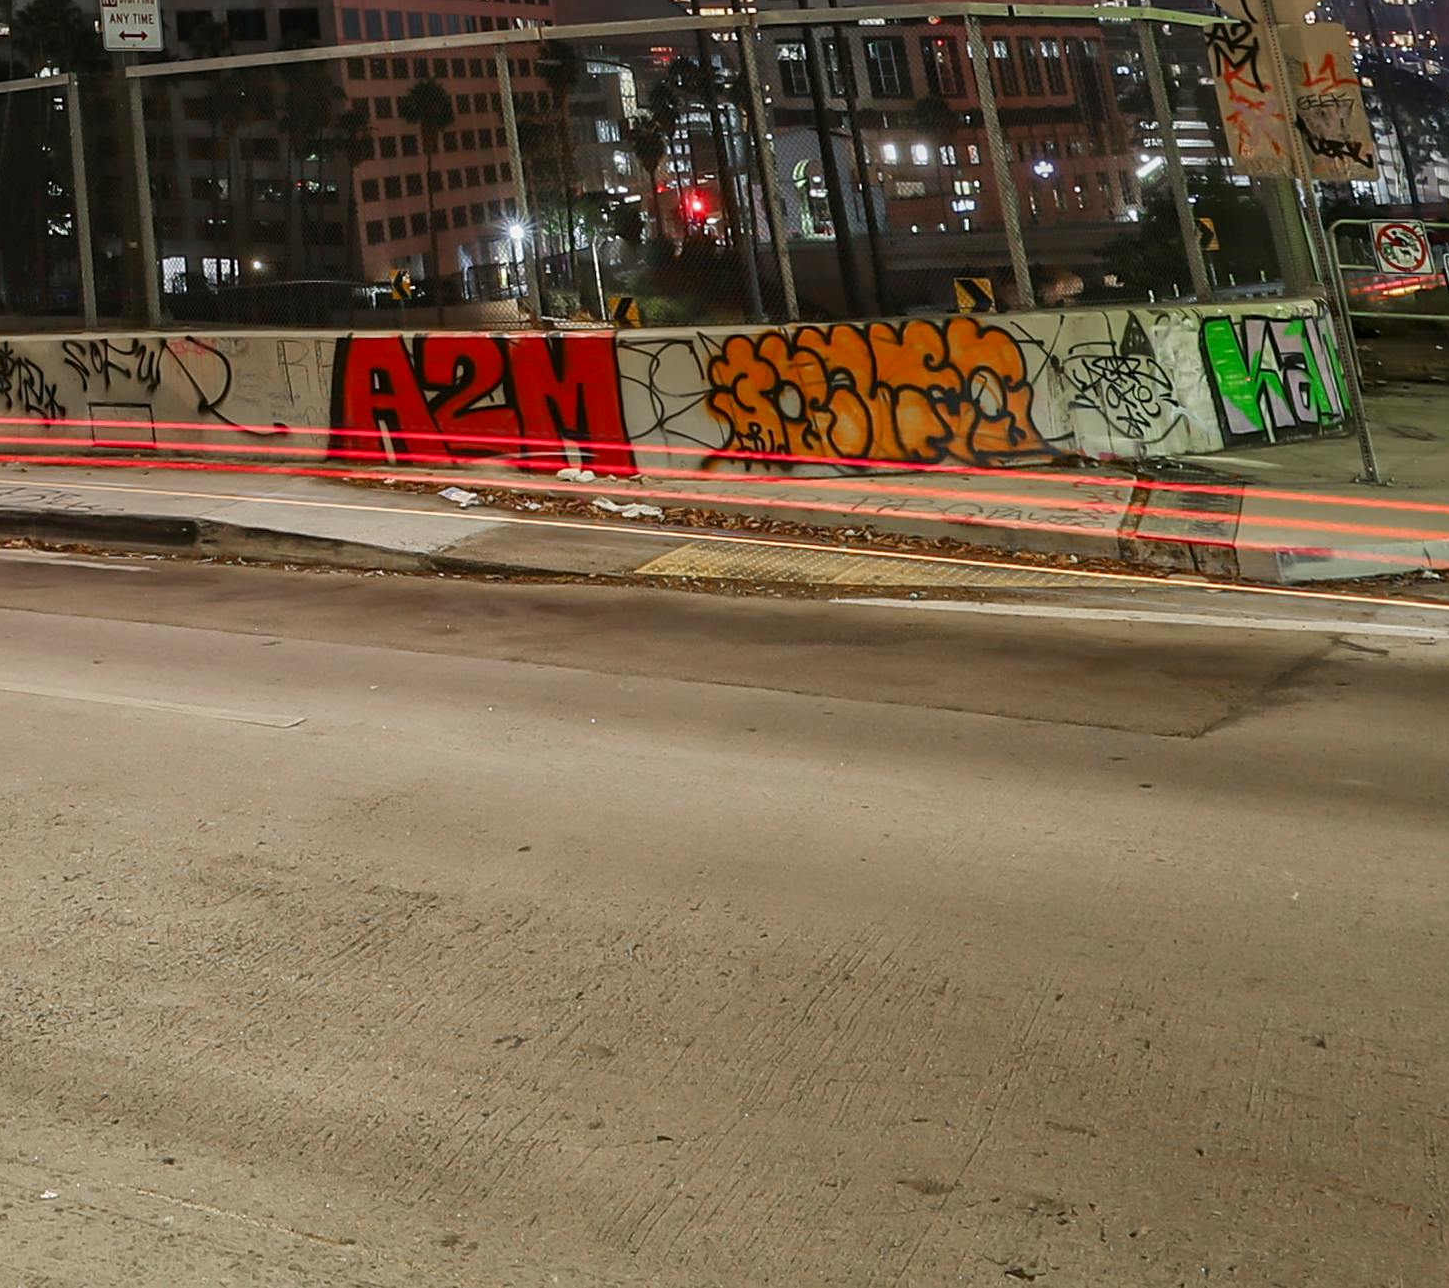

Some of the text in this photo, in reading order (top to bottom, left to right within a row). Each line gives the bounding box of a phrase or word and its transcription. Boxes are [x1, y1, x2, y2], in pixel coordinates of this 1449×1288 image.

[110, 13, 154, 25] ANY TIME
[331, 333, 639, 476] A2M
